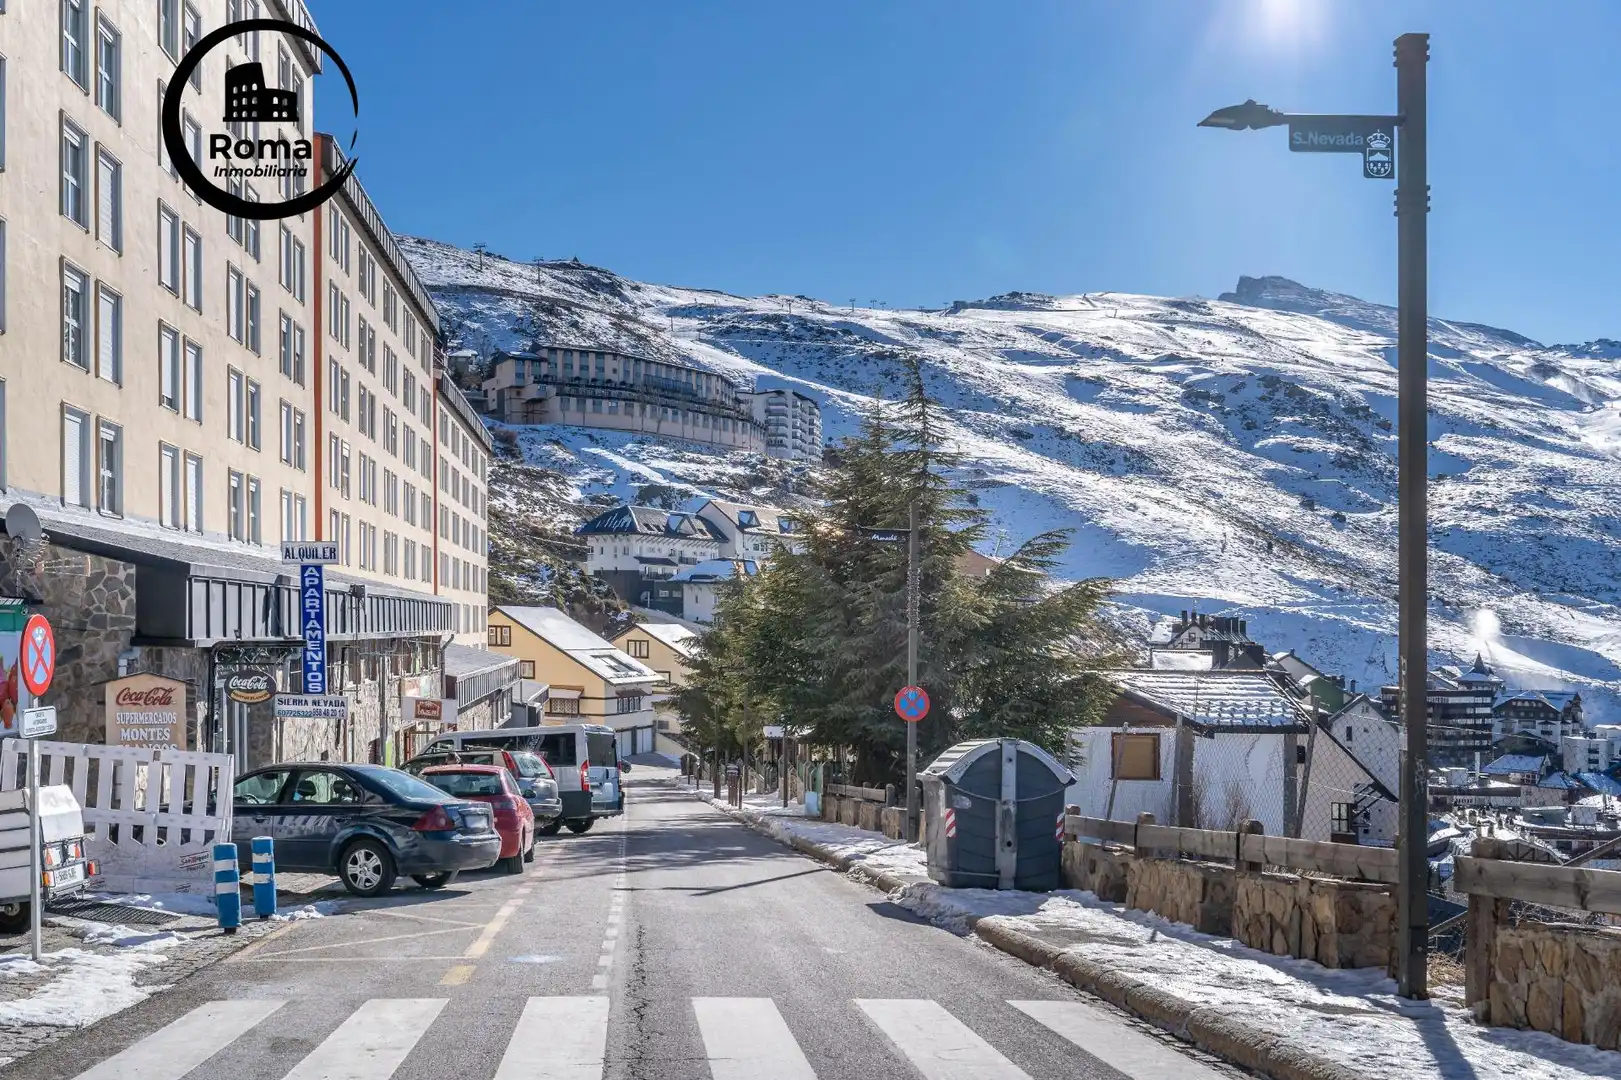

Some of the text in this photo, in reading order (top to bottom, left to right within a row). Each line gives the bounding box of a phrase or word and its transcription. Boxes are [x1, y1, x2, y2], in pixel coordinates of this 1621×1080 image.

[284, 546, 337, 562] ALQUILER
[303, 566, 324, 693] APARTAMENTOS
[115, 686, 177, 706] Coca-Cola
[277, 697, 346, 708] SIERRA NEVADA
[116, 711, 177, 725] SUPERMERCADOS
[120, 727, 171, 741] MONTES
